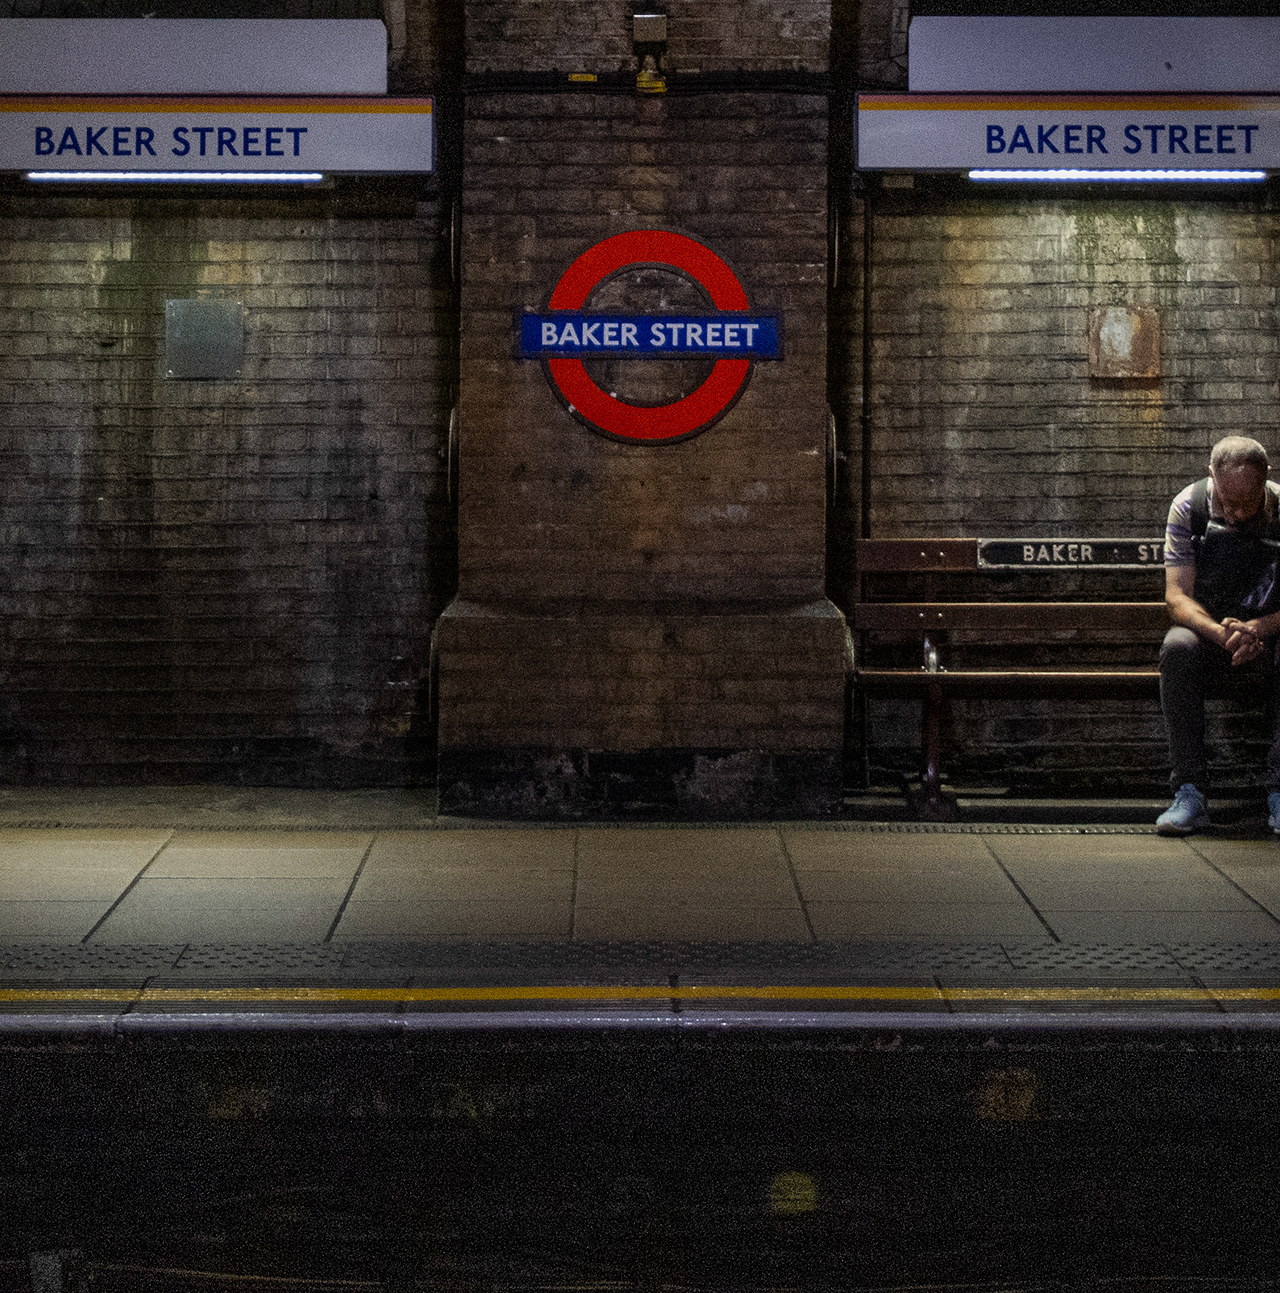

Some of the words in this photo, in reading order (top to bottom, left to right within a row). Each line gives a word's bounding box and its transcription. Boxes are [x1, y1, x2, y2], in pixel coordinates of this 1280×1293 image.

[34, 126, 157, 156] BAKER
[171, 126, 308, 157] STREET
[985, 124, 1109, 154] BAKER
[1122, 124, 1259, 154] STREET
[541, 322, 639, 346] BAKER
[649, 322, 759, 347] STREET
[1022, 544, 1093, 562] BAKER
